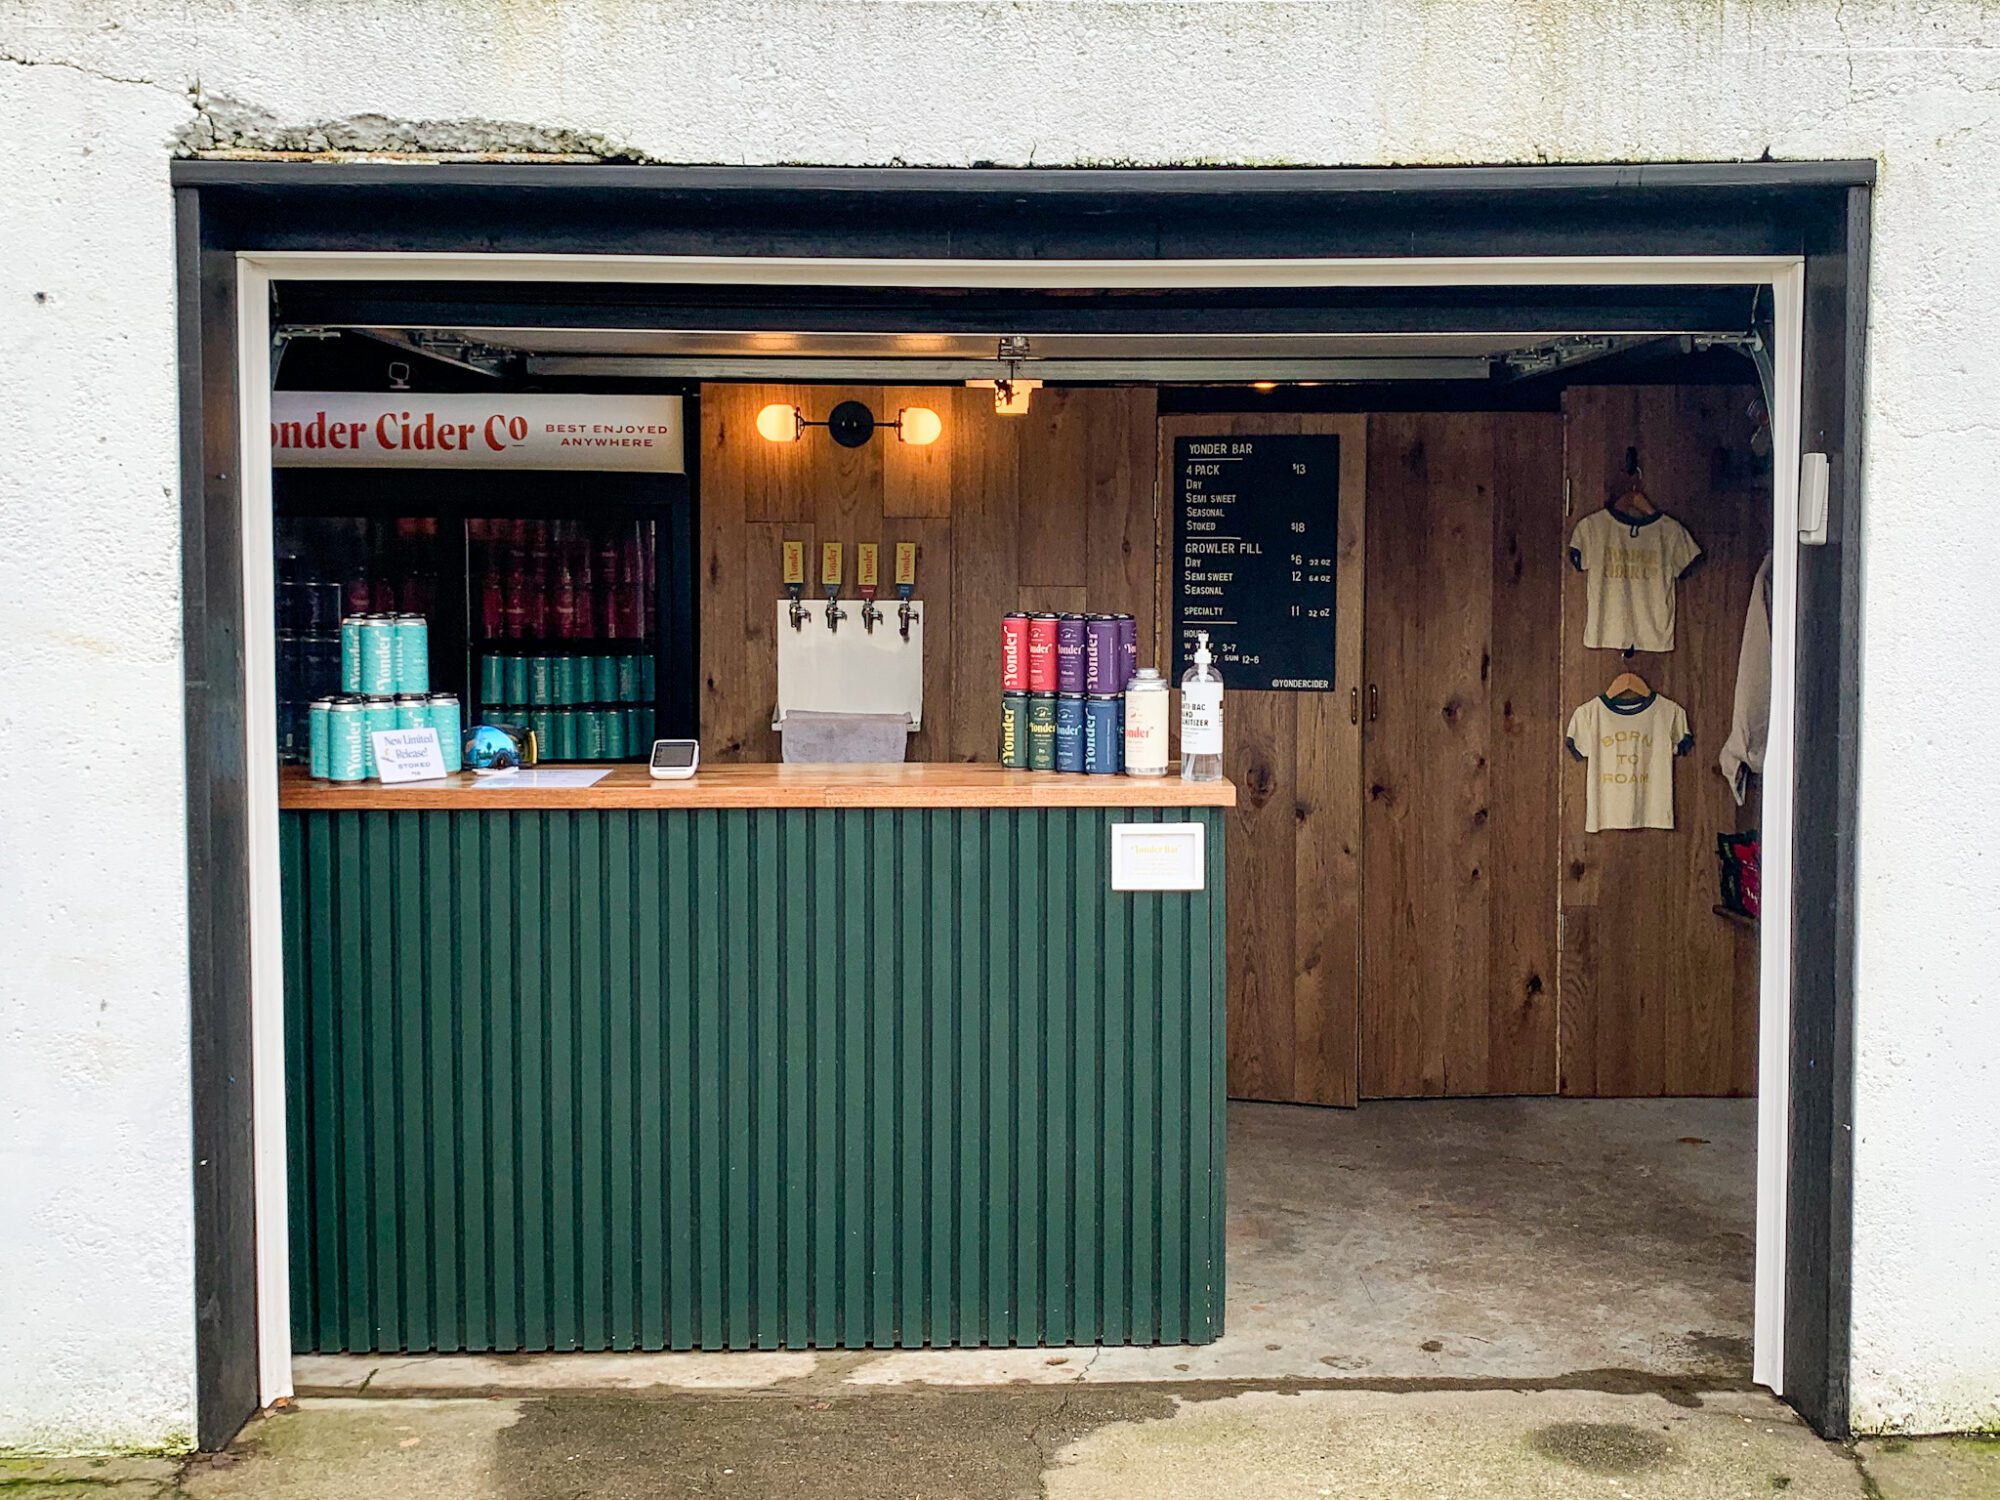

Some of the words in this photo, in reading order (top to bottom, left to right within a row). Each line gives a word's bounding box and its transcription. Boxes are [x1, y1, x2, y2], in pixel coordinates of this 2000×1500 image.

[376, 411, 475, 451] Cider
[484, 413, 528, 452] Co
[545, 424, 587, 433] BEST
[593, 425, 668, 434] ENJOYED
[560, 438, 654, 447] ANYWHERE
[1188, 443, 1228, 455] YONDER
[1231, 443, 1253, 455] BAR
[1186, 464, 1193, 476] 4
[1194, 464, 1220, 476] PACK
[1292, 463, 1307, 475] $13
[1210, 494, 1237, 503] SWEET
[1291, 522, 1306, 533] $18
[1185, 543, 1235, 554] GROWLER
[1239, 543, 1263, 554] FILL
[1290, 554, 1303, 566] $6
[1207, 572, 1234, 582] SWEET
[1291, 571, 1302, 582] 12
[1184, 606, 1224, 616] SPECIALTY
[1308, 609, 1318, 617] 32
[1183, 642, 1191, 650] W
[1222, 643, 1237, 652] 3-7
[374, 630, 391, 691] Yonder
[1003, 625, 1018, 687] Yonder
[1087, 626, 1098, 690] Yonder
[1224, 654, 1239, 662] SUN
[1242, 655, 1260, 664] 12-6
[1272, 679, 1329, 689] @YONDERCIDER
[1001, 701, 1015, 764] Yonder
[384, 736, 402, 746] New
[403, 733, 434, 745] Limited
[1085, 707, 1096, 770] Yonder
[1602, 731, 1654, 747] BORN
[345, 715, 361, 777] Yonder
[1616, 754, 1639, 765] TO
[1602, 773, 1650, 784] ROAM
